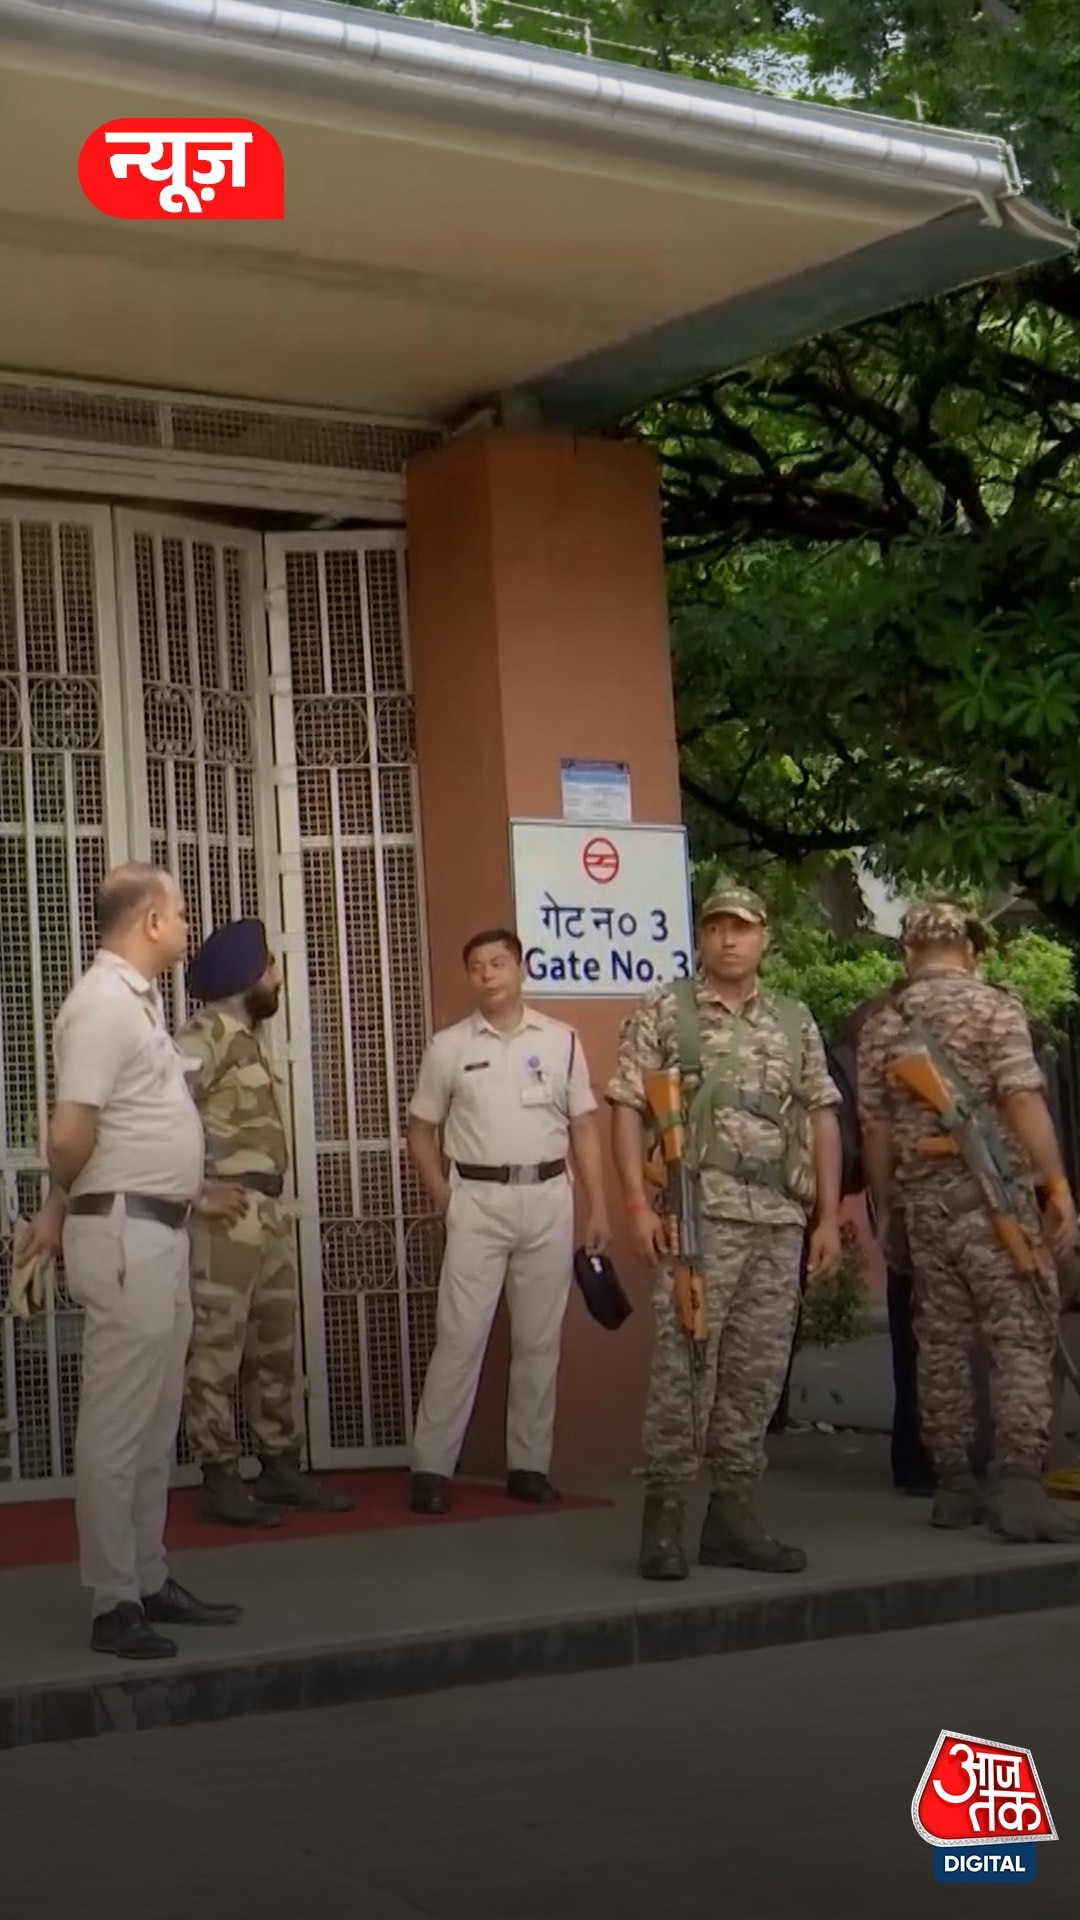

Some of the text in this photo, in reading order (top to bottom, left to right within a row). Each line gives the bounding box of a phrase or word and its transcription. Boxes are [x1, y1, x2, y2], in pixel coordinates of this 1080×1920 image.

[540, 892, 585, 939] गेट
[651, 909, 669, 942] 3
[525, 947, 689, 983] Gate No. 3
